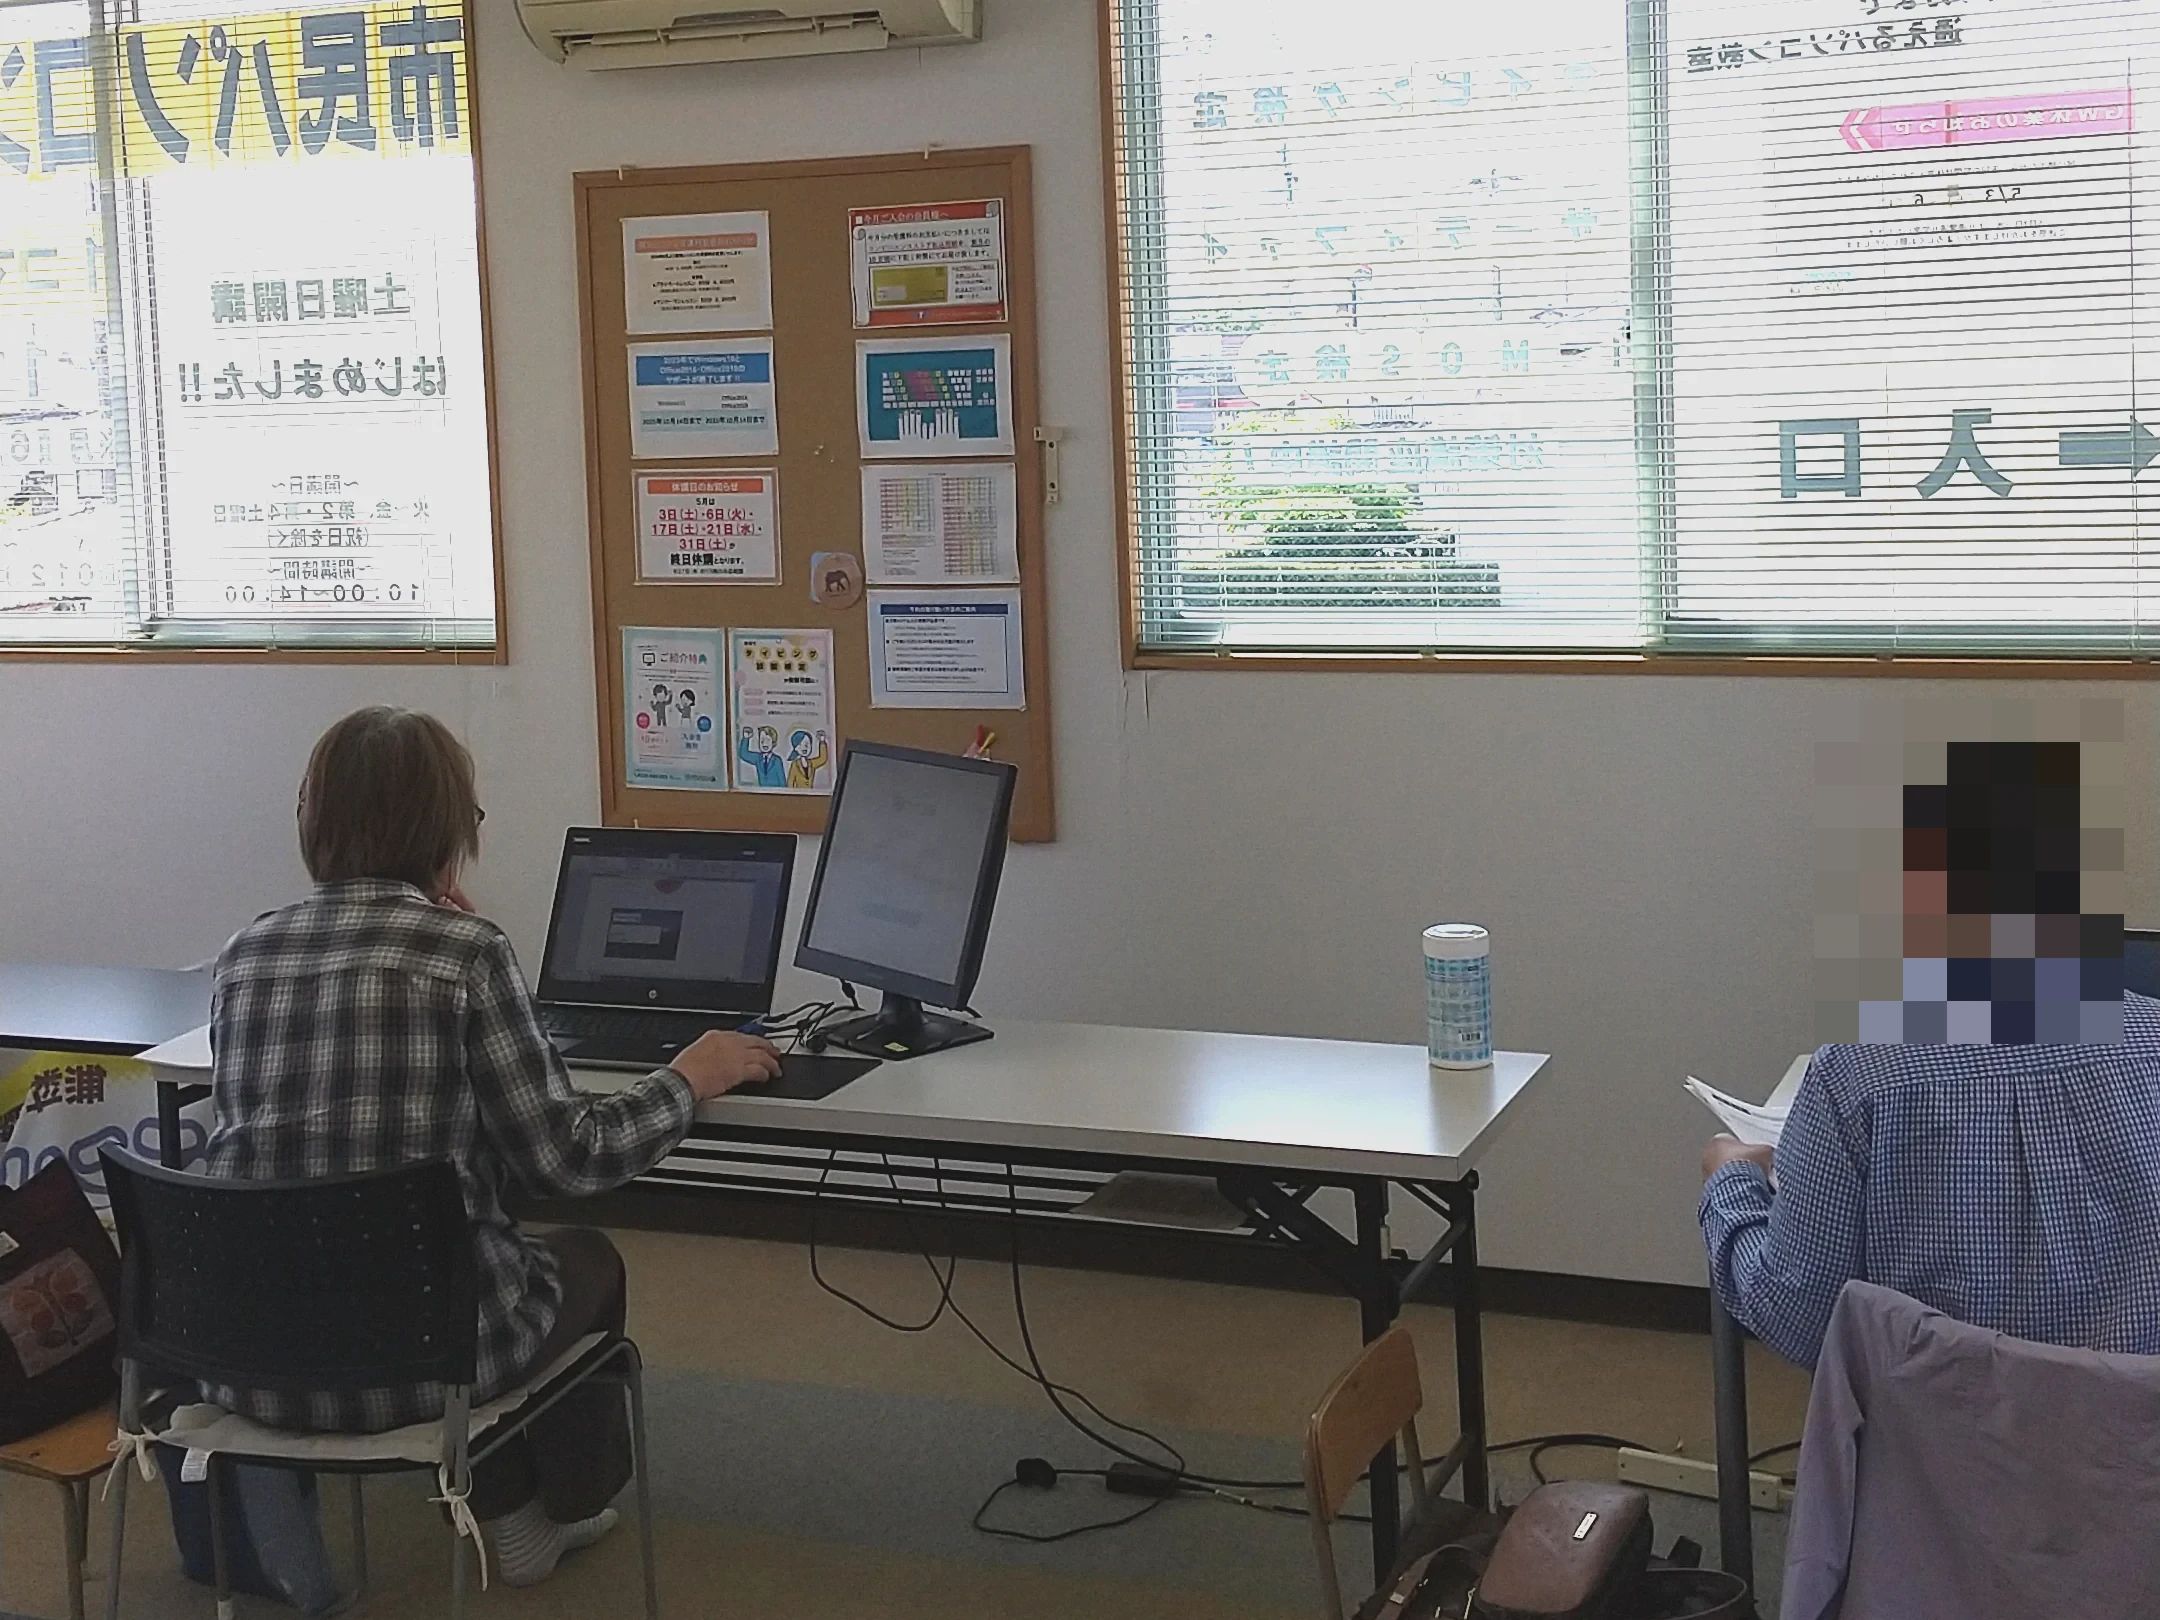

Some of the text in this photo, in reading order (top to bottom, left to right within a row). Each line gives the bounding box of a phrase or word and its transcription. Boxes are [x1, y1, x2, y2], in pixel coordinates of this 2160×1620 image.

[695, 497, 716, 506] 5月は
[660, 652, 708, 665] ご紹介特典
